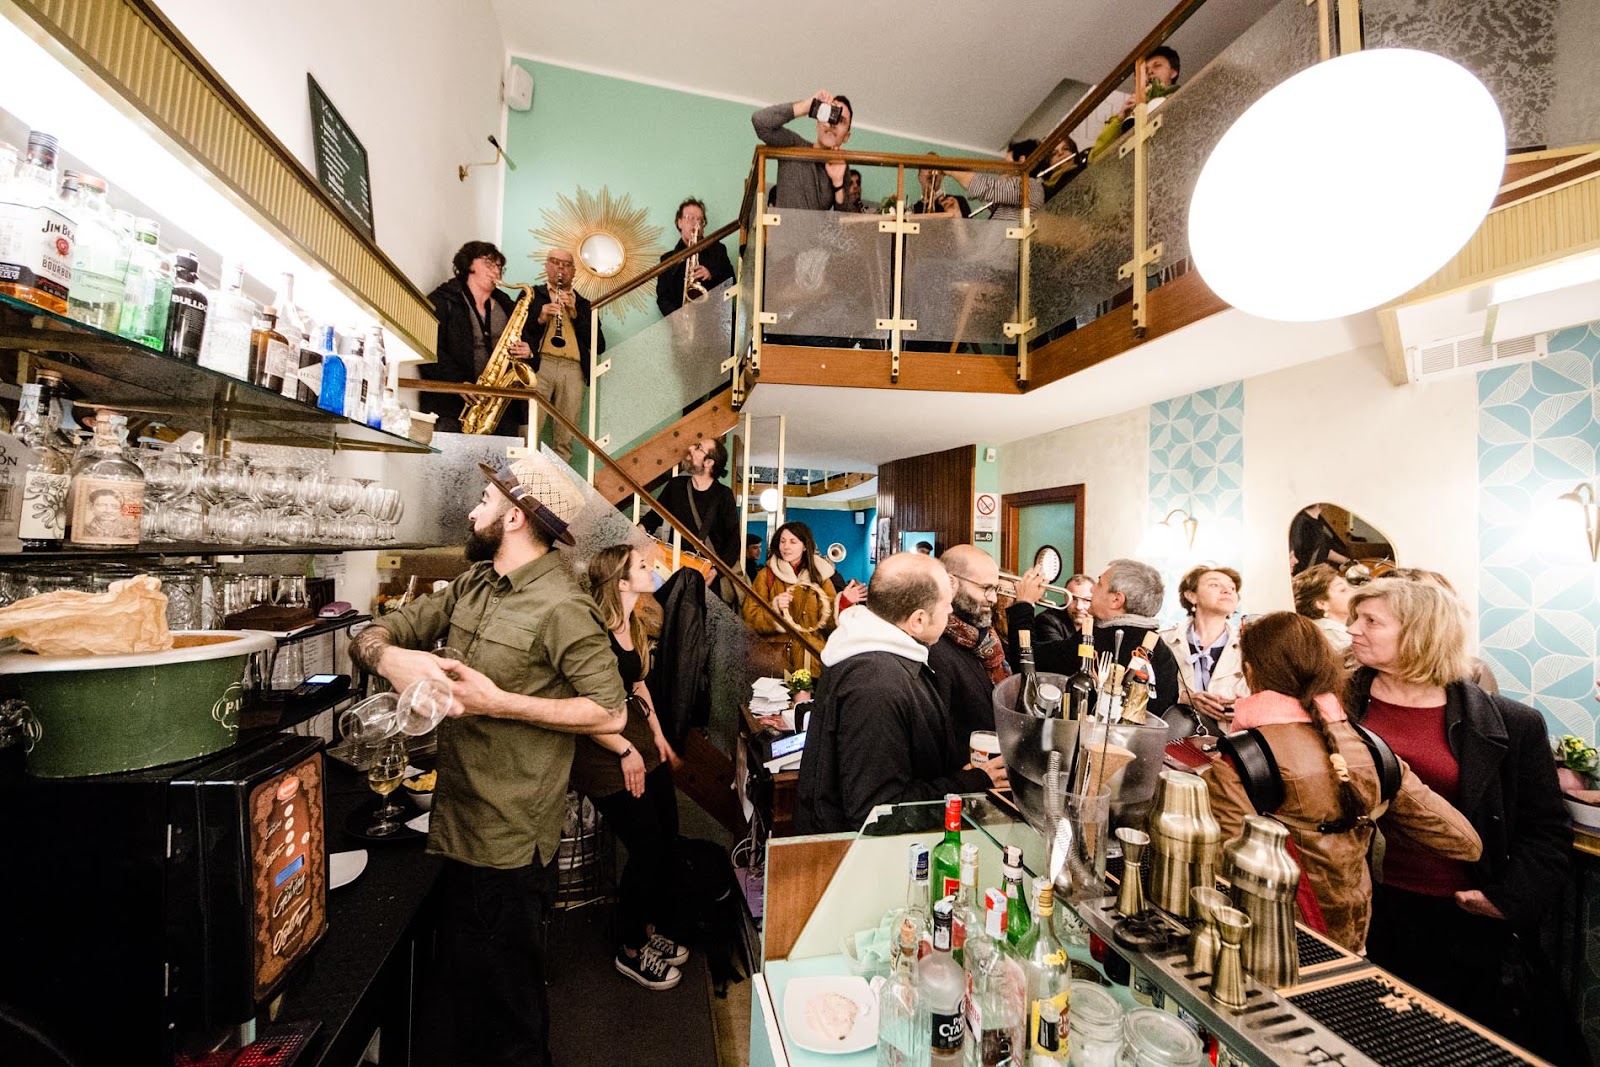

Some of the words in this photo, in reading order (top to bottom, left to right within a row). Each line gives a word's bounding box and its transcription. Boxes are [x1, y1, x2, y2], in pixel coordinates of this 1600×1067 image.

[41, 220, 61, 233] JIM
[62, 224, 76, 243] BEA
[42, 258, 72, 280] BOURBON
[172, 294, 208, 313] BULLDO
